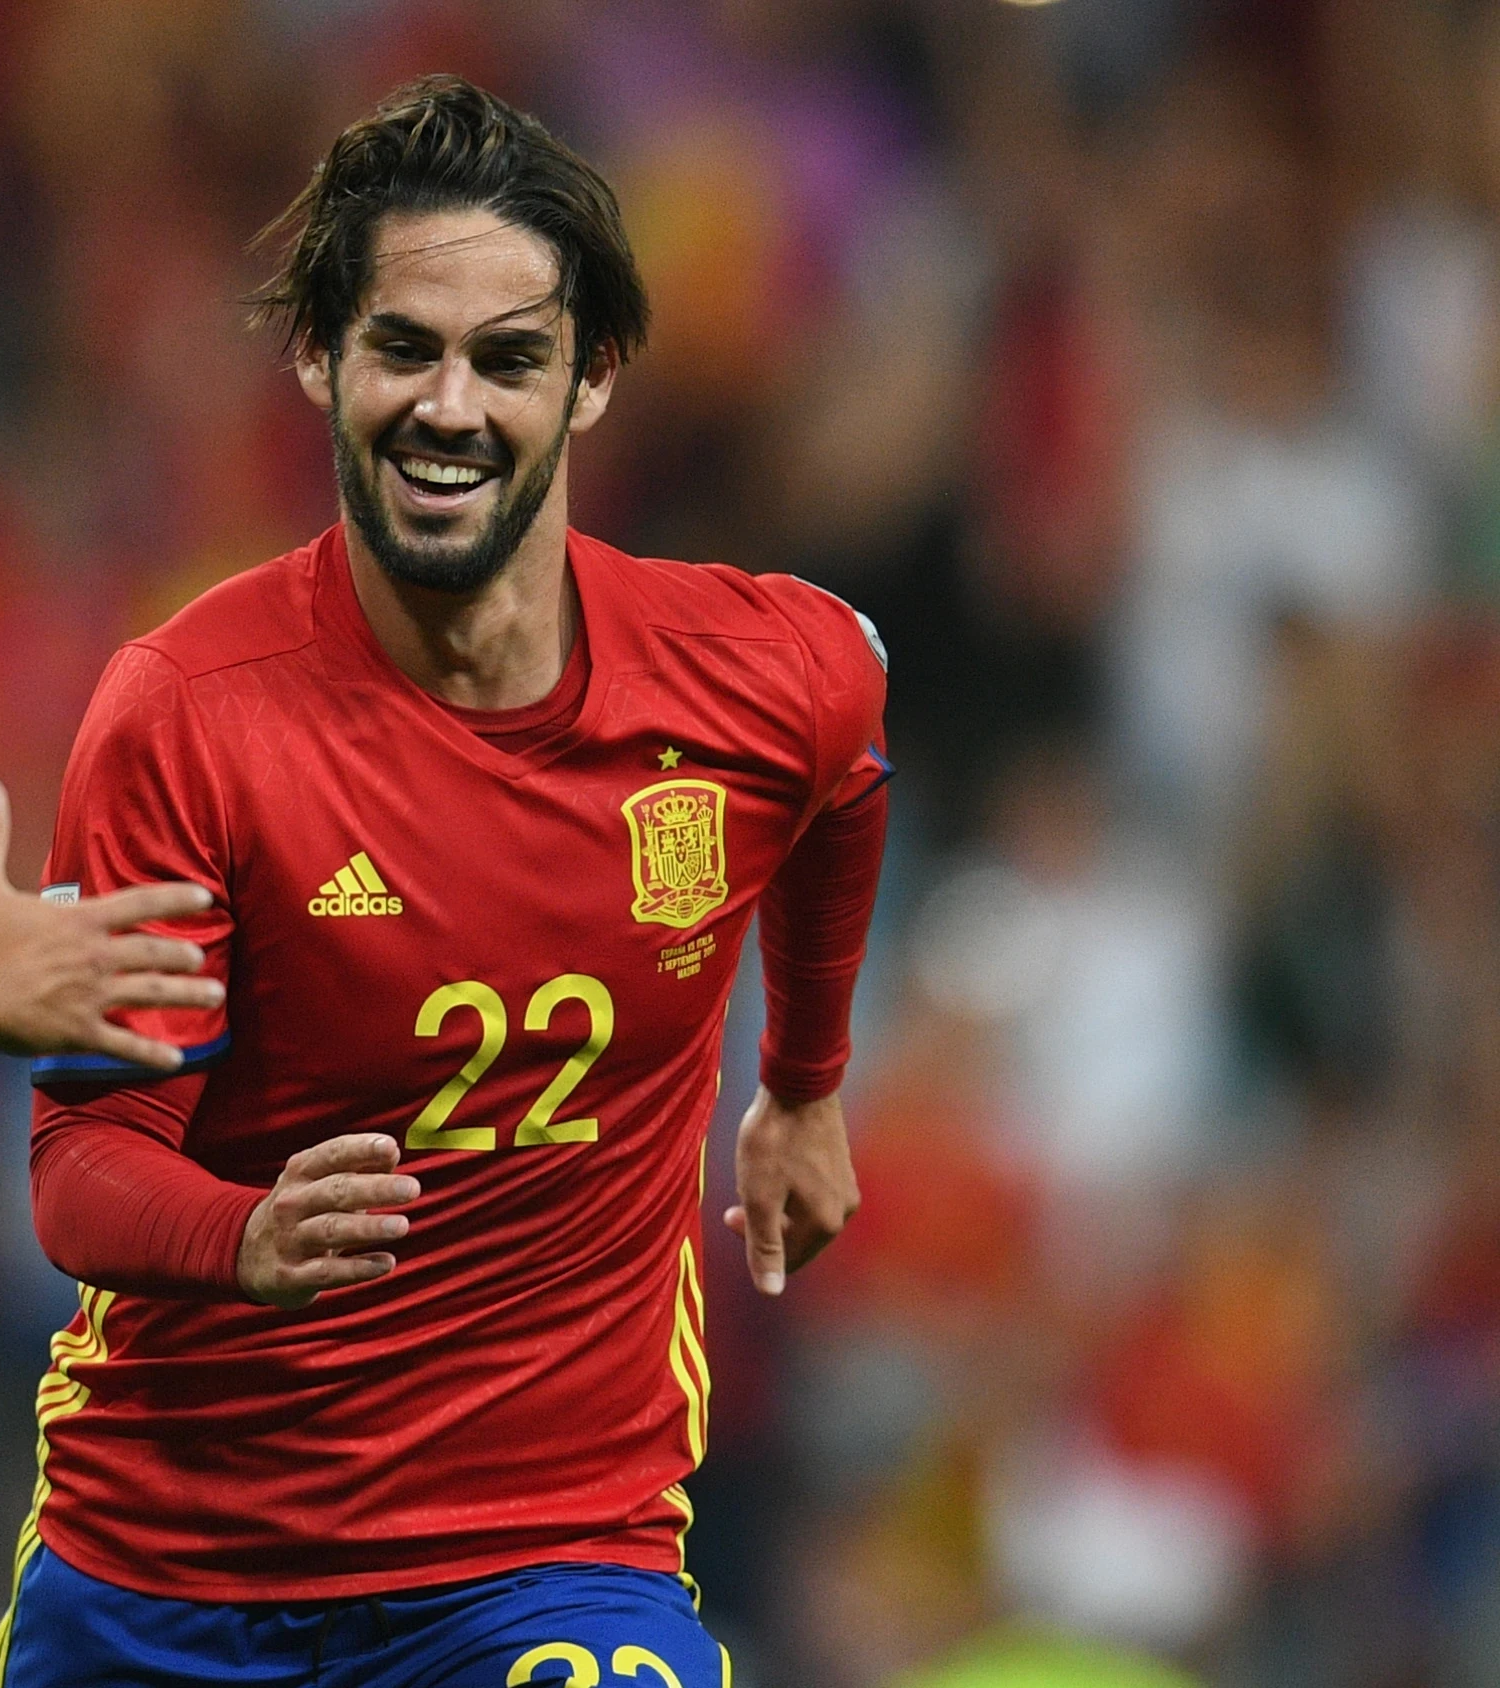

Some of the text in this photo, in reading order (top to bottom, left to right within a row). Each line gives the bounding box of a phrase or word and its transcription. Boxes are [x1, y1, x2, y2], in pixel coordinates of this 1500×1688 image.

[308, 892, 403, 916] adidas
[657, 962, 663, 973] 2
[664, 949, 702, 971] SEPTIEMBRE
[677, 962, 701, 980] MADRID
[405, 973, 614, 1151] 22
